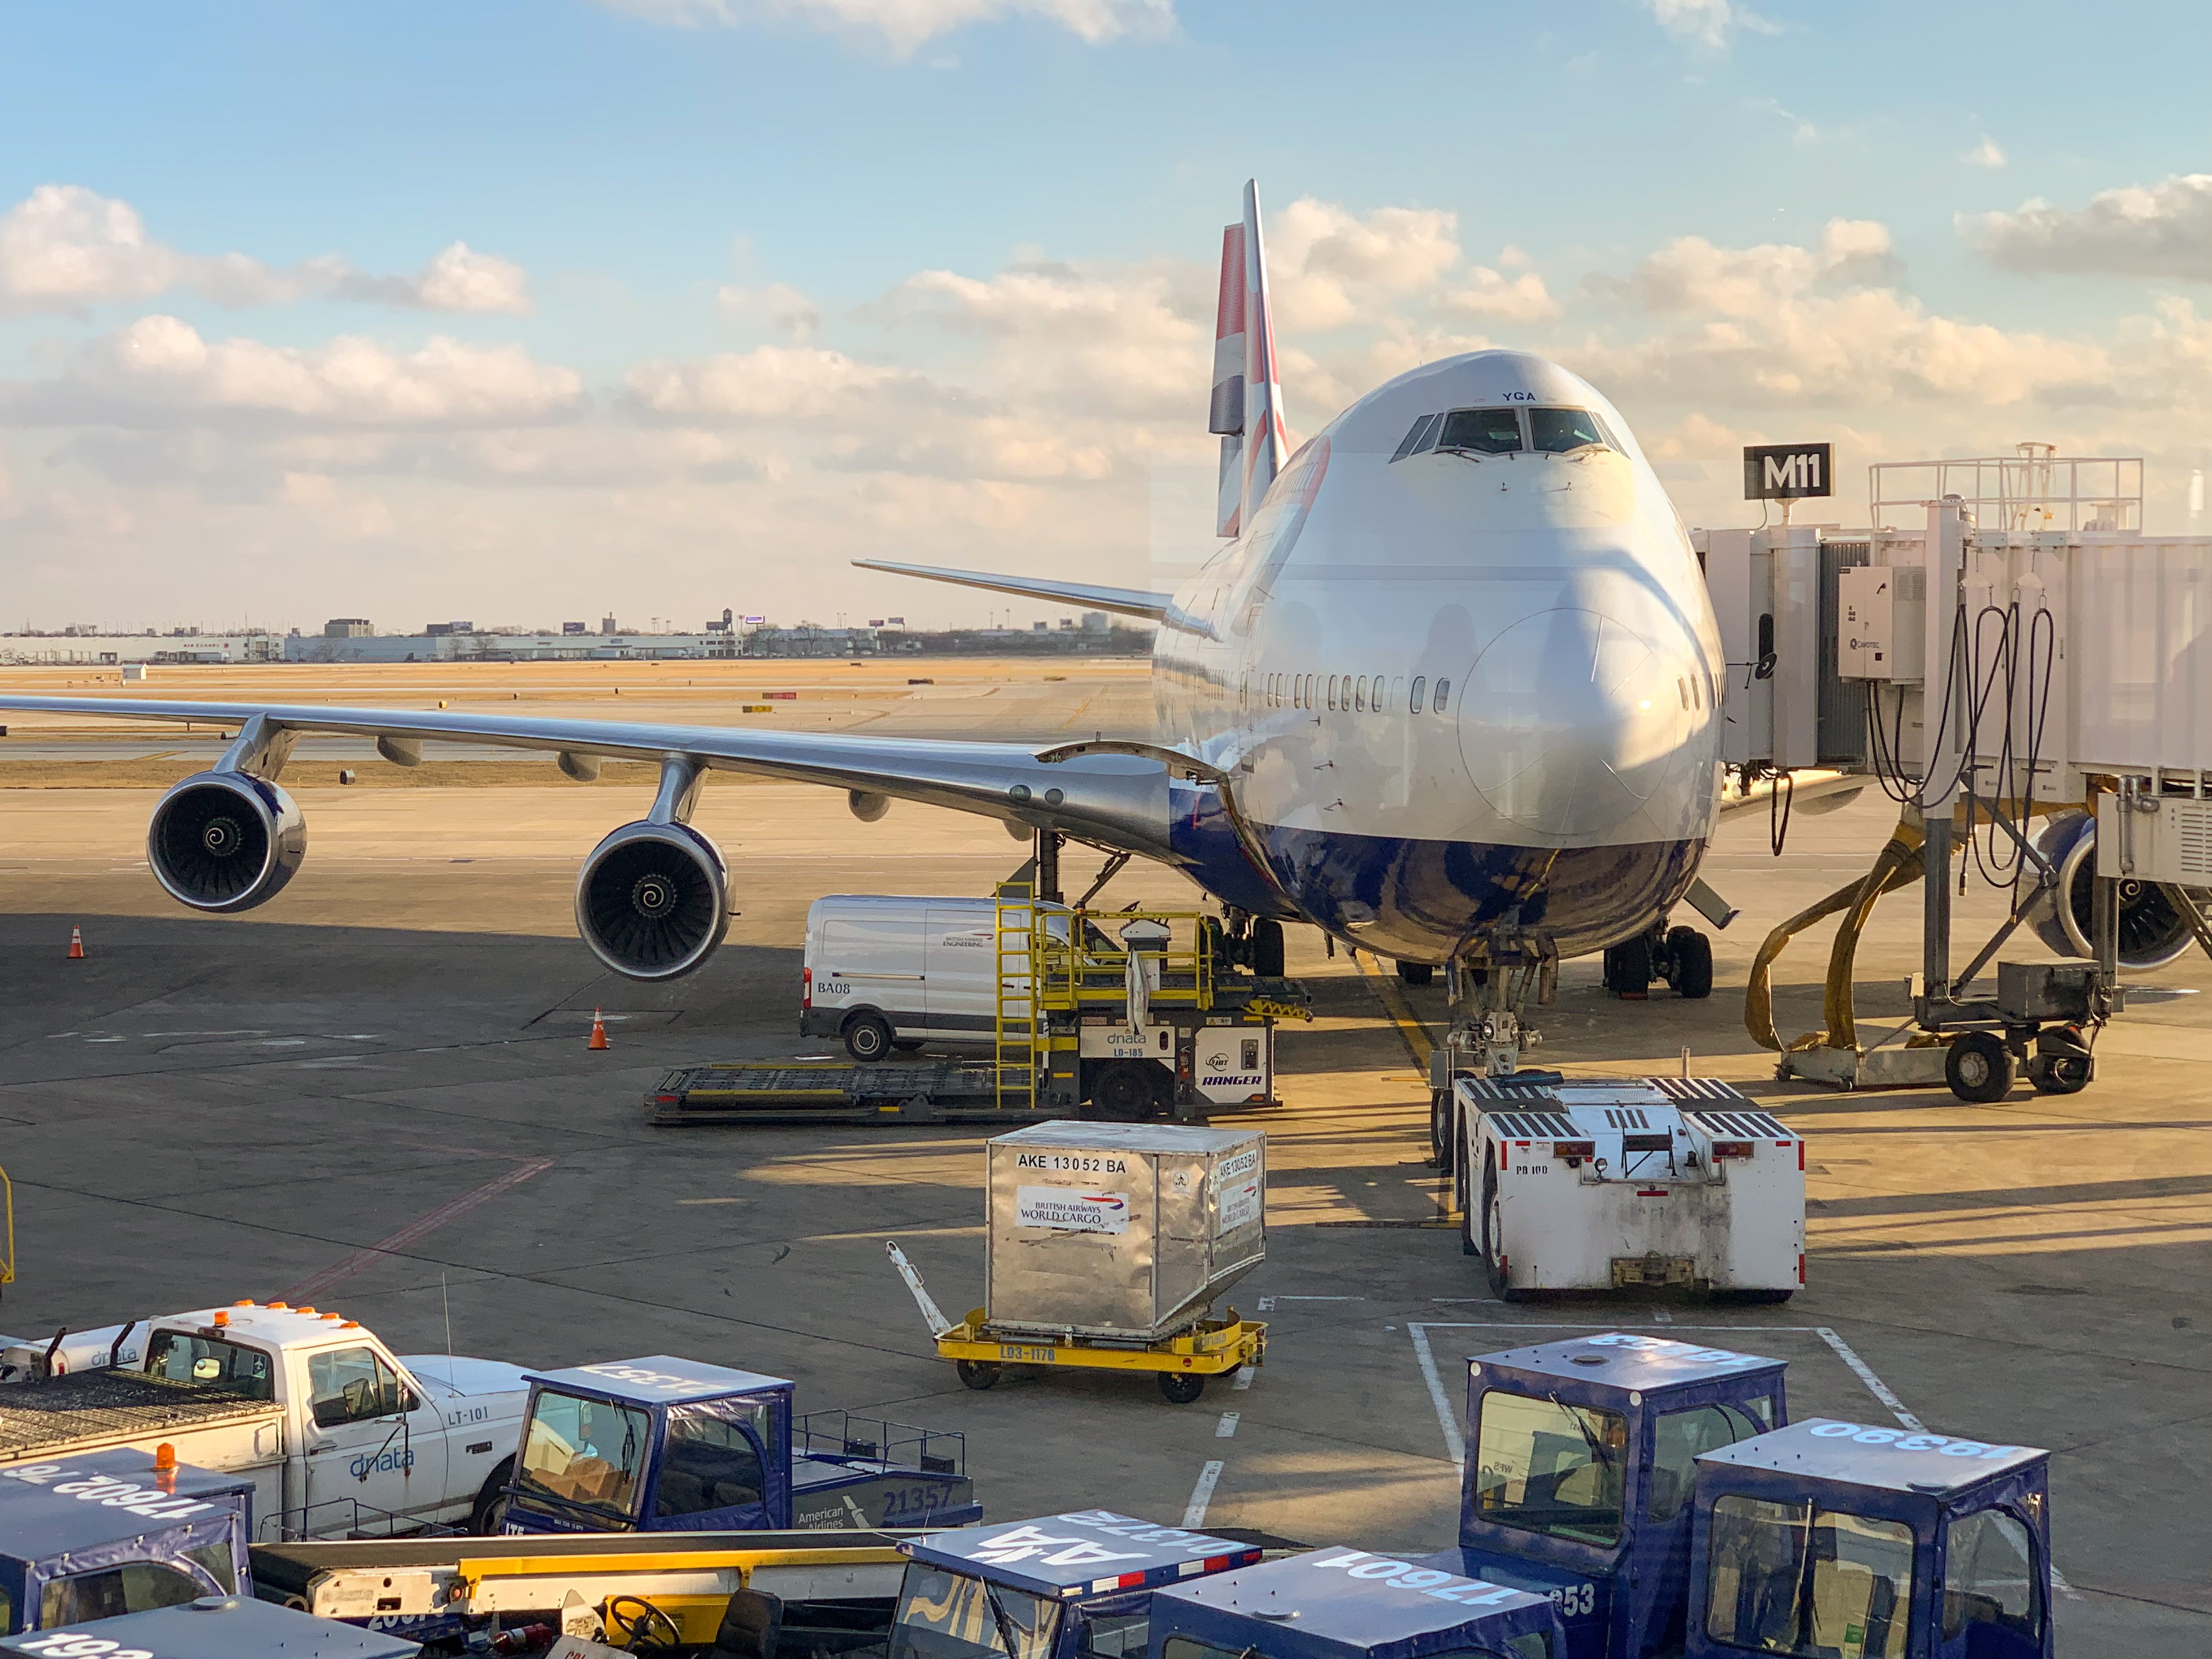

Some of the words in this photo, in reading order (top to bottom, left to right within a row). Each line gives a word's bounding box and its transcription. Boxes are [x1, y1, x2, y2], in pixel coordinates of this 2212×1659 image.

[1502, 392, 1536, 401] YGA
[1764, 453, 1821, 490] M11
[818, 982, 851, 994] BA08
[1107, 1032, 1147, 1044] dnata
[1202, 1076, 1262, 1086] RANGER
[1018, 1154, 1047, 1168] AKE
[1054, 1156, 1100, 1171] 13052
[1106, 1160, 1126, 1173] BA
[1220, 1162, 1231, 1177] AKE
[1231, 1156, 1248, 1173] 13052
[1248, 1153, 1256, 1167] BA
[1516, 1166, 1528, 1175] PB
[1021, 1208, 1060, 1221] WORLD
[1062, 1212, 1101, 1224] CARGO
[1035, 1201, 1066, 1211] BRITISH
[1068, 1204, 1101, 1214] AIRWAYS
[577, 1365, 732, 1393] 21357
[447, 1406, 488, 1425] LT-101
[1810, 1423, 2019, 1460] 19390
[349, 1447, 415, 1477] dnata
[52, 1475, 216, 1519] 17602
[883, 1483, 954, 1518] 21357
[799, 1506, 843, 1525] American
[808, 1518, 843, 1530] Airlines
[1311, 1551, 1521, 1606] 17601
